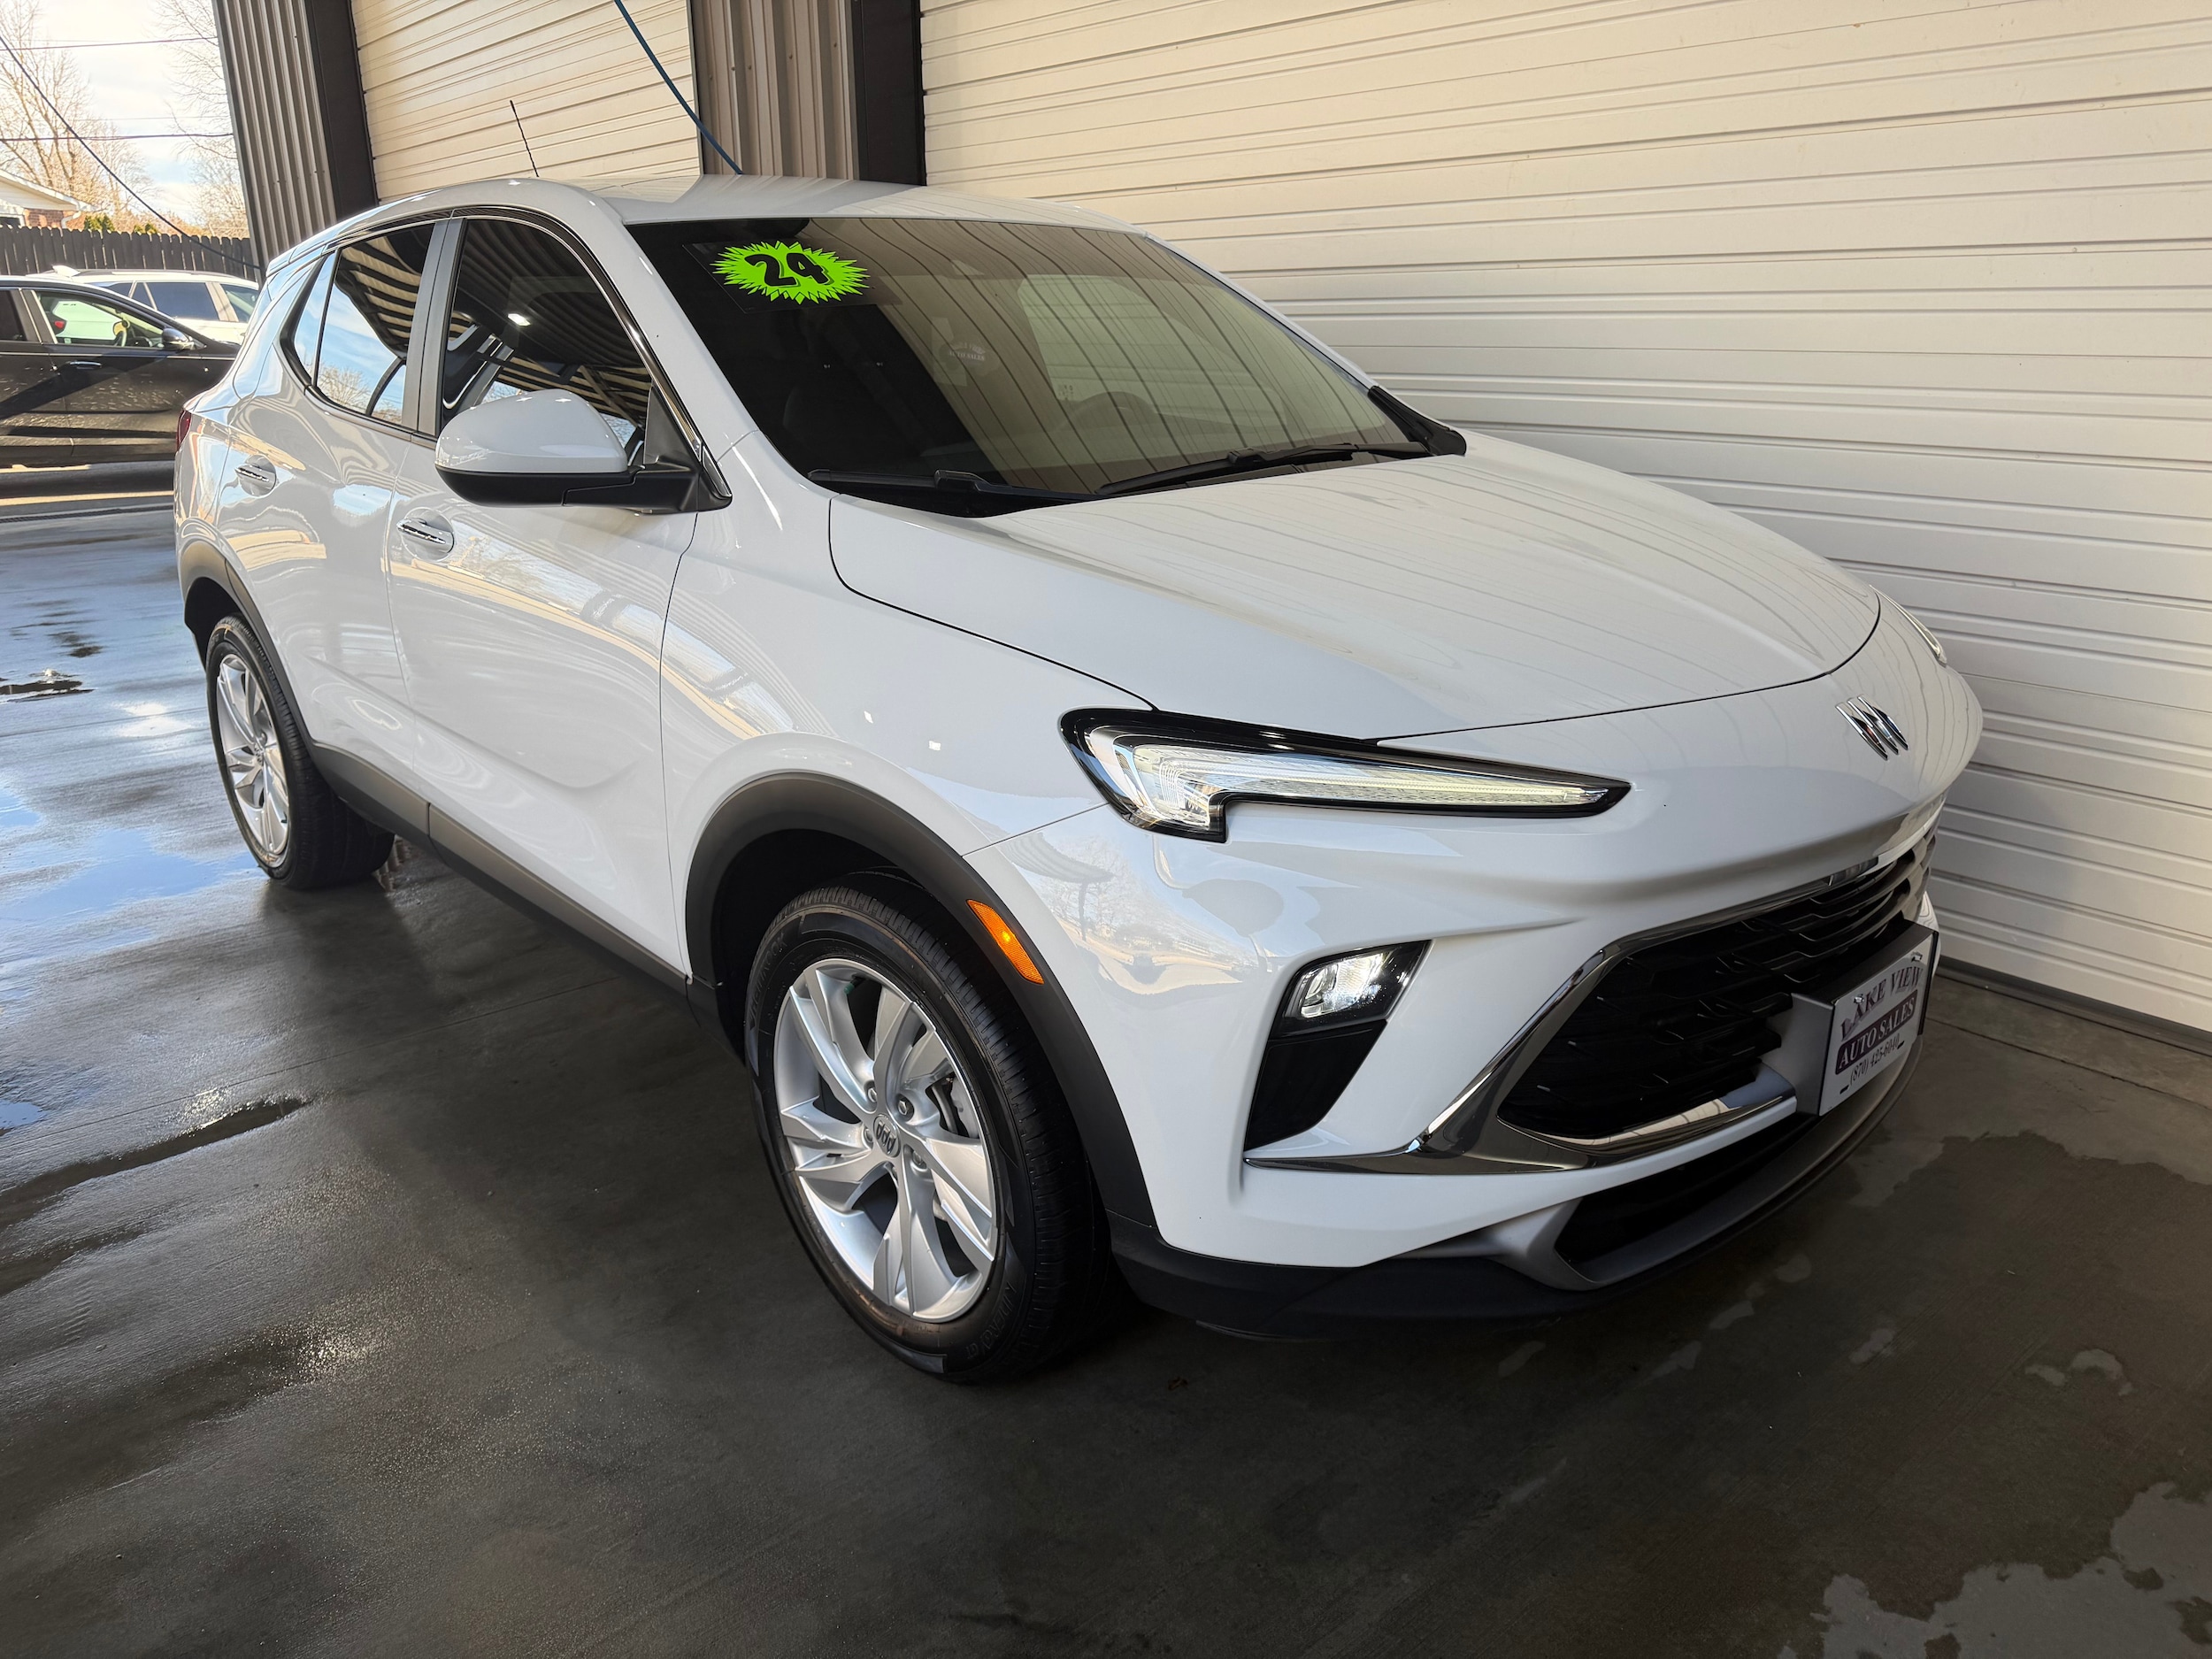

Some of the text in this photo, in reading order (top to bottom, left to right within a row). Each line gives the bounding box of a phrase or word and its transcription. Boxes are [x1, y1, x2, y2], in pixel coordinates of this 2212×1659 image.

[744, 252, 834, 288] 24
[1840, 966, 1922, 1040] LAKE VIEW
[1839, 996, 1915, 1070] AUTO SALES
[1849, 1060, 1869, 1086] (870)
